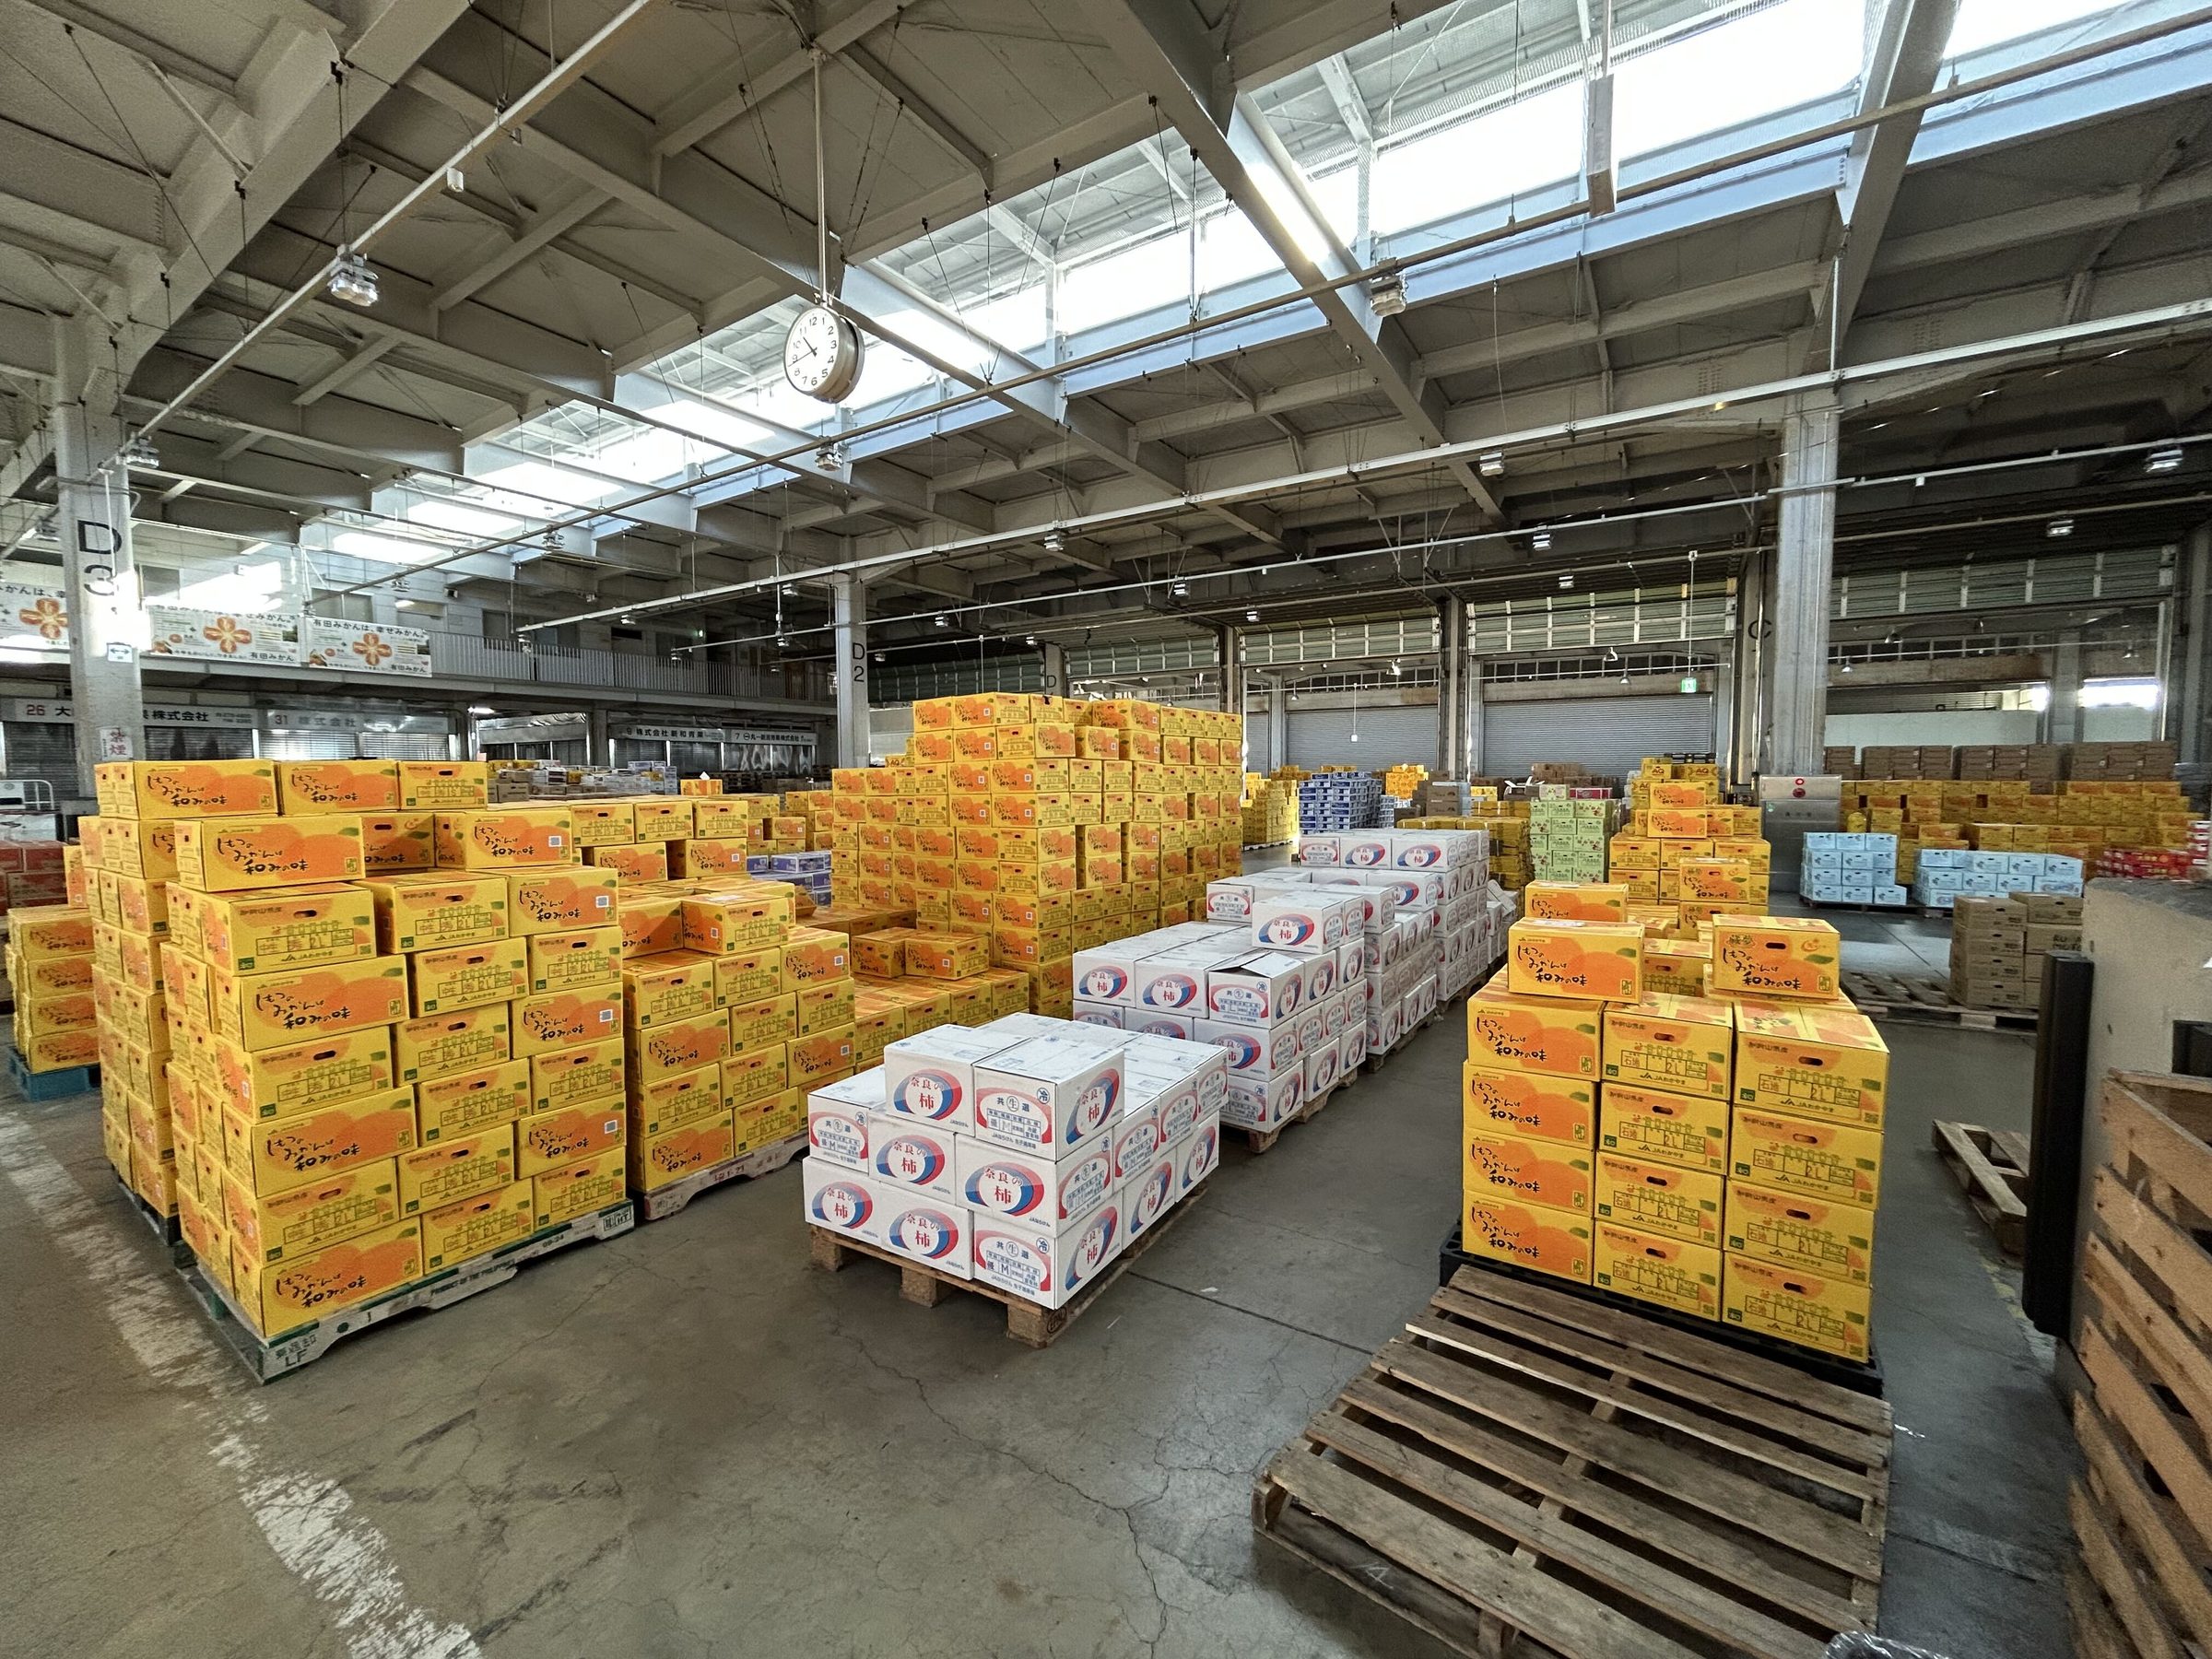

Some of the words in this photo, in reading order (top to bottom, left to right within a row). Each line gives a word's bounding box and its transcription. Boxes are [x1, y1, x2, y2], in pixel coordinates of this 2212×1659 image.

[809, 317, 817, 326] 12
[828, 326, 833, 335] 2
[830, 340, 837, 348] 3
[828, 356, 834, 364] 4
[794, 368, 800, 376] 8
[822, 369, 828, 378] 5
[802, 376, 807, 384] 7
[811, 377, 818, 385] 6
[251, 652, 294, 662] 有田みかん
[27, 704, 45, 716] 26
[275, 714, 288, 725] 31
[1279, 928, 1293, 941] 柿
[1163, 990, 1175, 1002] 柿
[911, 1077, 944, 1091] 奈良の
[919, 1093, 935, 1110] 柿
[1088, 1105, 1100, 1123] 柿
[830, 1140, 836, 1151] M
[893, 1141, 926, 1157] 奈良の
[901, 1158, 916, 1174] 柿
[984, 1167, 1023, 1186] 奈良の
[826, 1187, 856, 1203] 奈良の
[994, 1186, 1011, 1204] 柿
[834, 1203, 848, 1218] 柿
[905, 1213, 940, 1231] 奈良の
[915, 1230, 930, 1248] 柿
[1002, 1264, 1009, 1275] M
